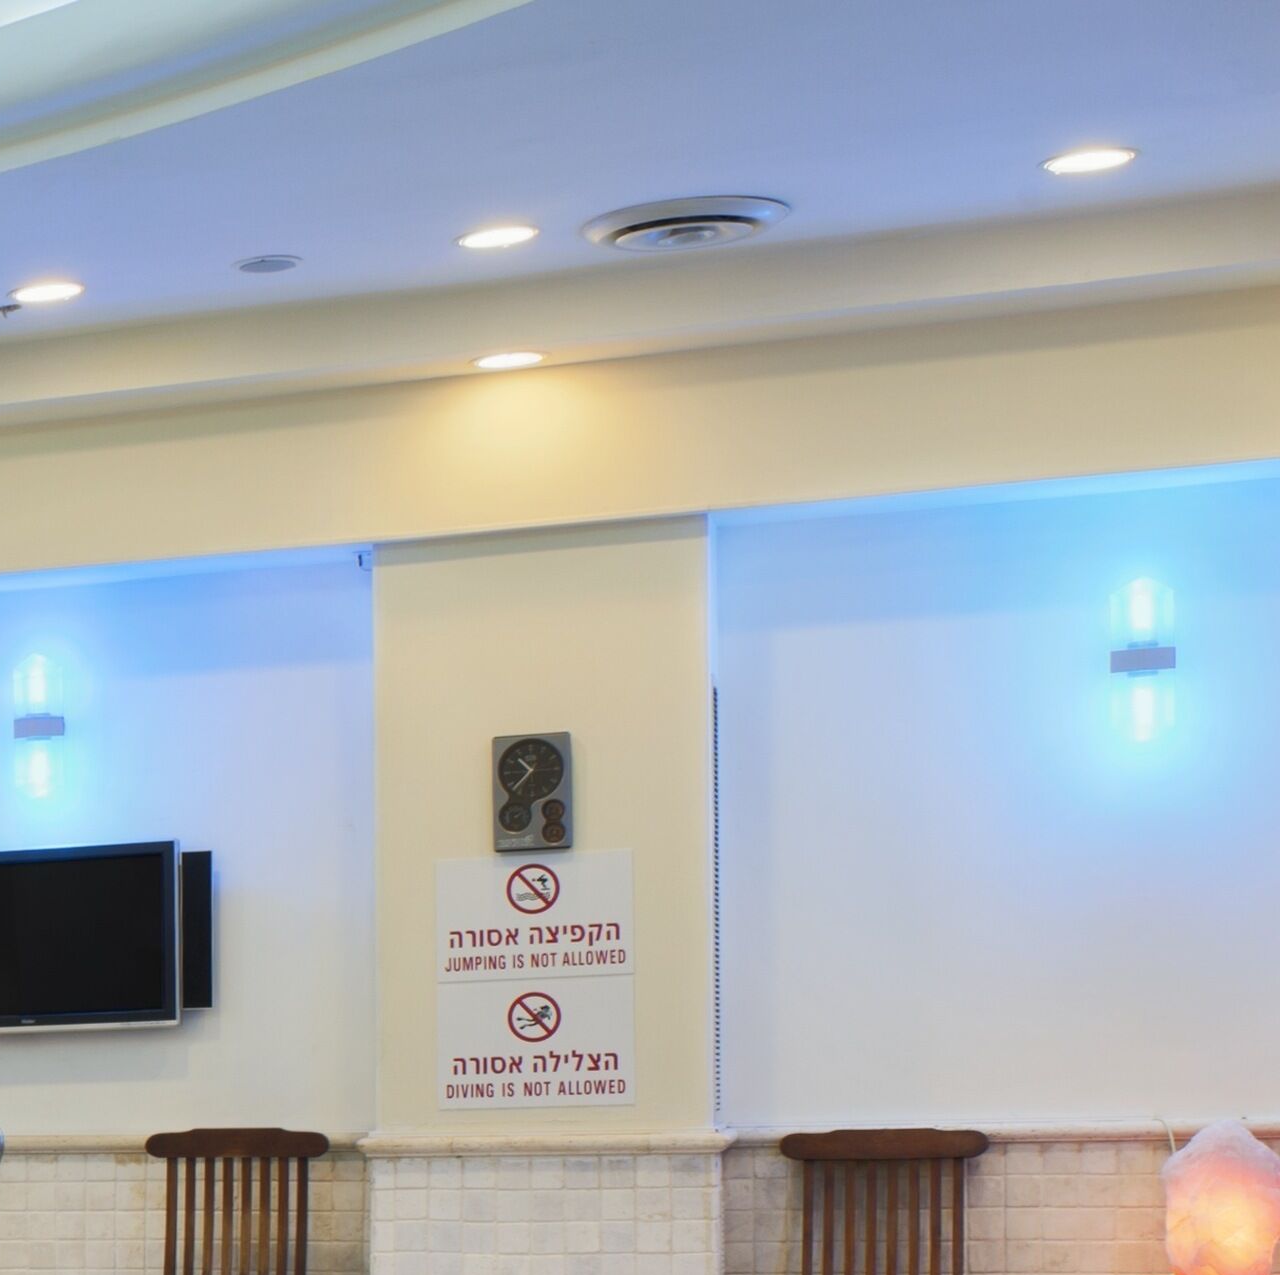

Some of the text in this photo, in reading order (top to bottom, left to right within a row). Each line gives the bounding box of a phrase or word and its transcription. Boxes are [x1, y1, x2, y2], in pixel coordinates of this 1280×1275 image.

[449, 923, 620, 948] הקפיצה אסורה
[445, 949, 626, 972] JUMPING IS NOT ALLOWED
[453, 1050, 618, 1075] הצלילה אסורה
[446, 1079, 626, 1099] DIVING IS NOT ALLOWED
